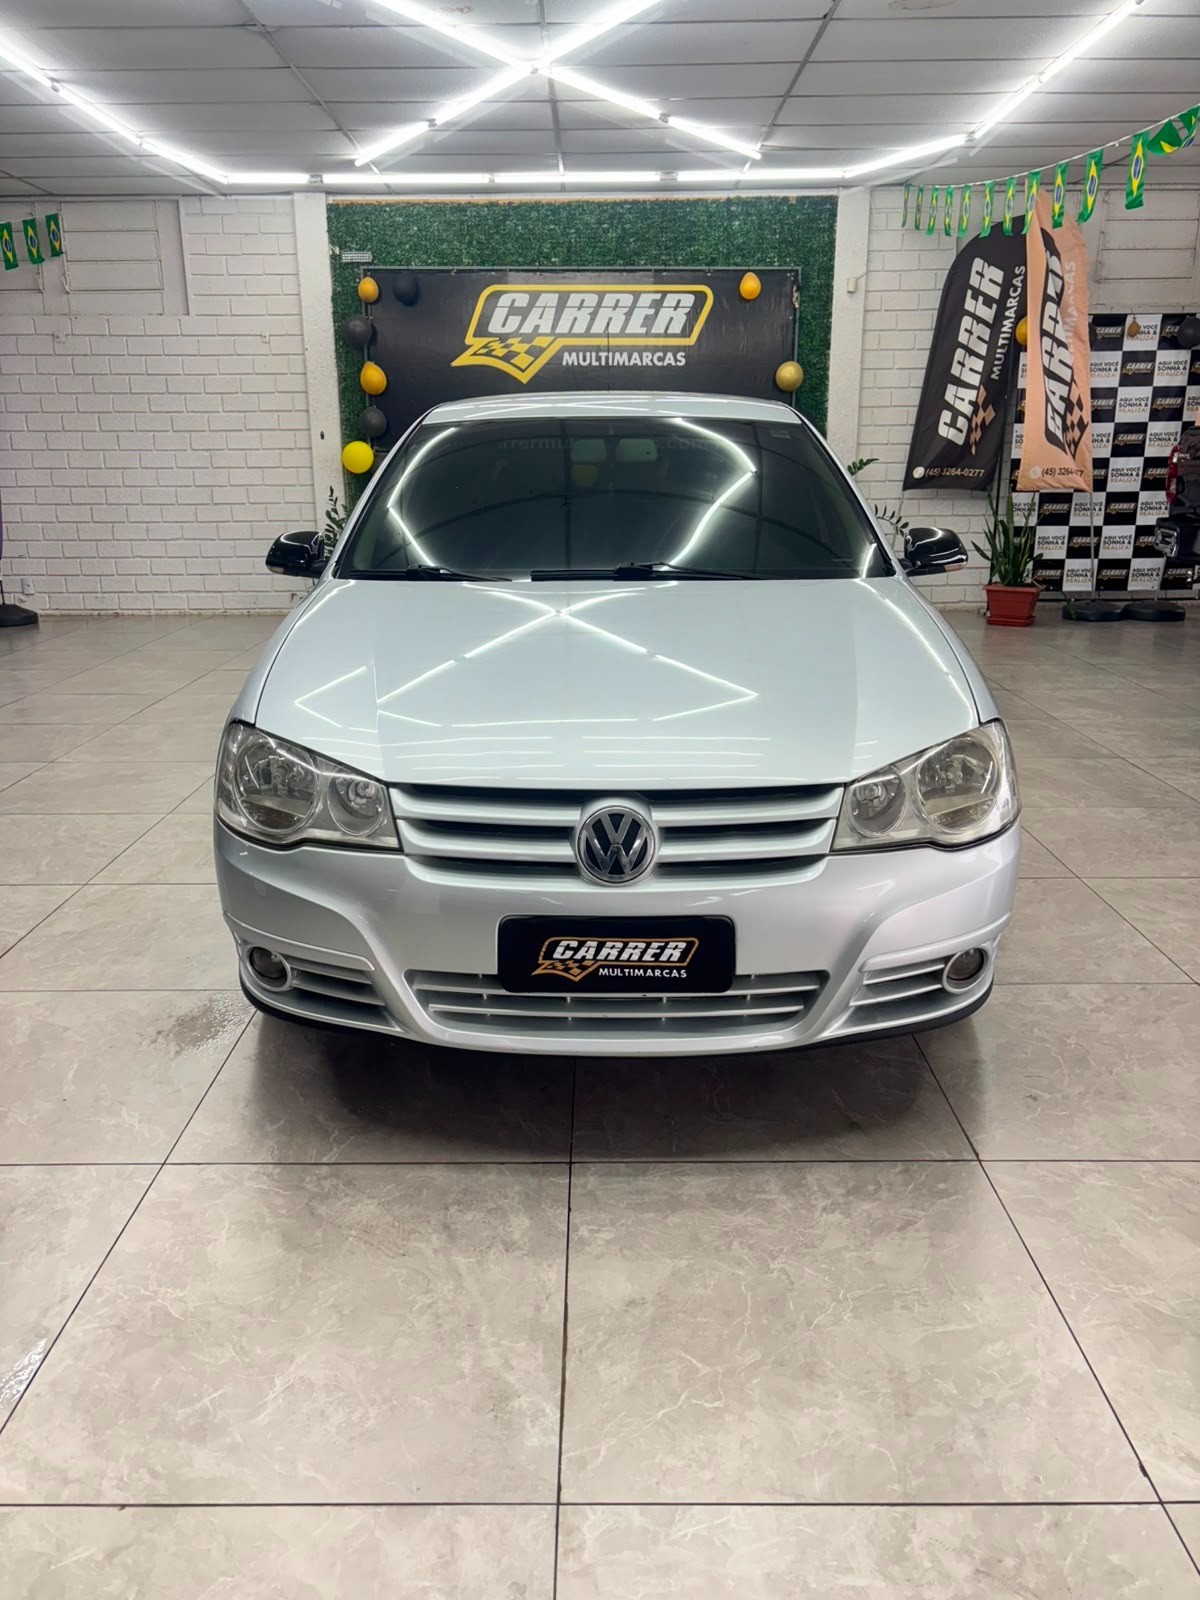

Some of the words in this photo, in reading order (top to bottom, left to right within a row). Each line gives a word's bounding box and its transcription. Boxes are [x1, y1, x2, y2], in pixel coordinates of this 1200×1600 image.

[488, 293, 695, 334] CARRER
[990, 265, 1025, 380] MULTIMARCAS
[562, 352, 686, 366] MULTIMARCAS
[938, 257, 1004, 445] CARRER
[926, 468, 941, 478] (45)
[1042, 467, 1056, 478] (45)
[552, 940, 687, 961] CARRER
[598, 967, 687, 978] MULTIMARCAS
